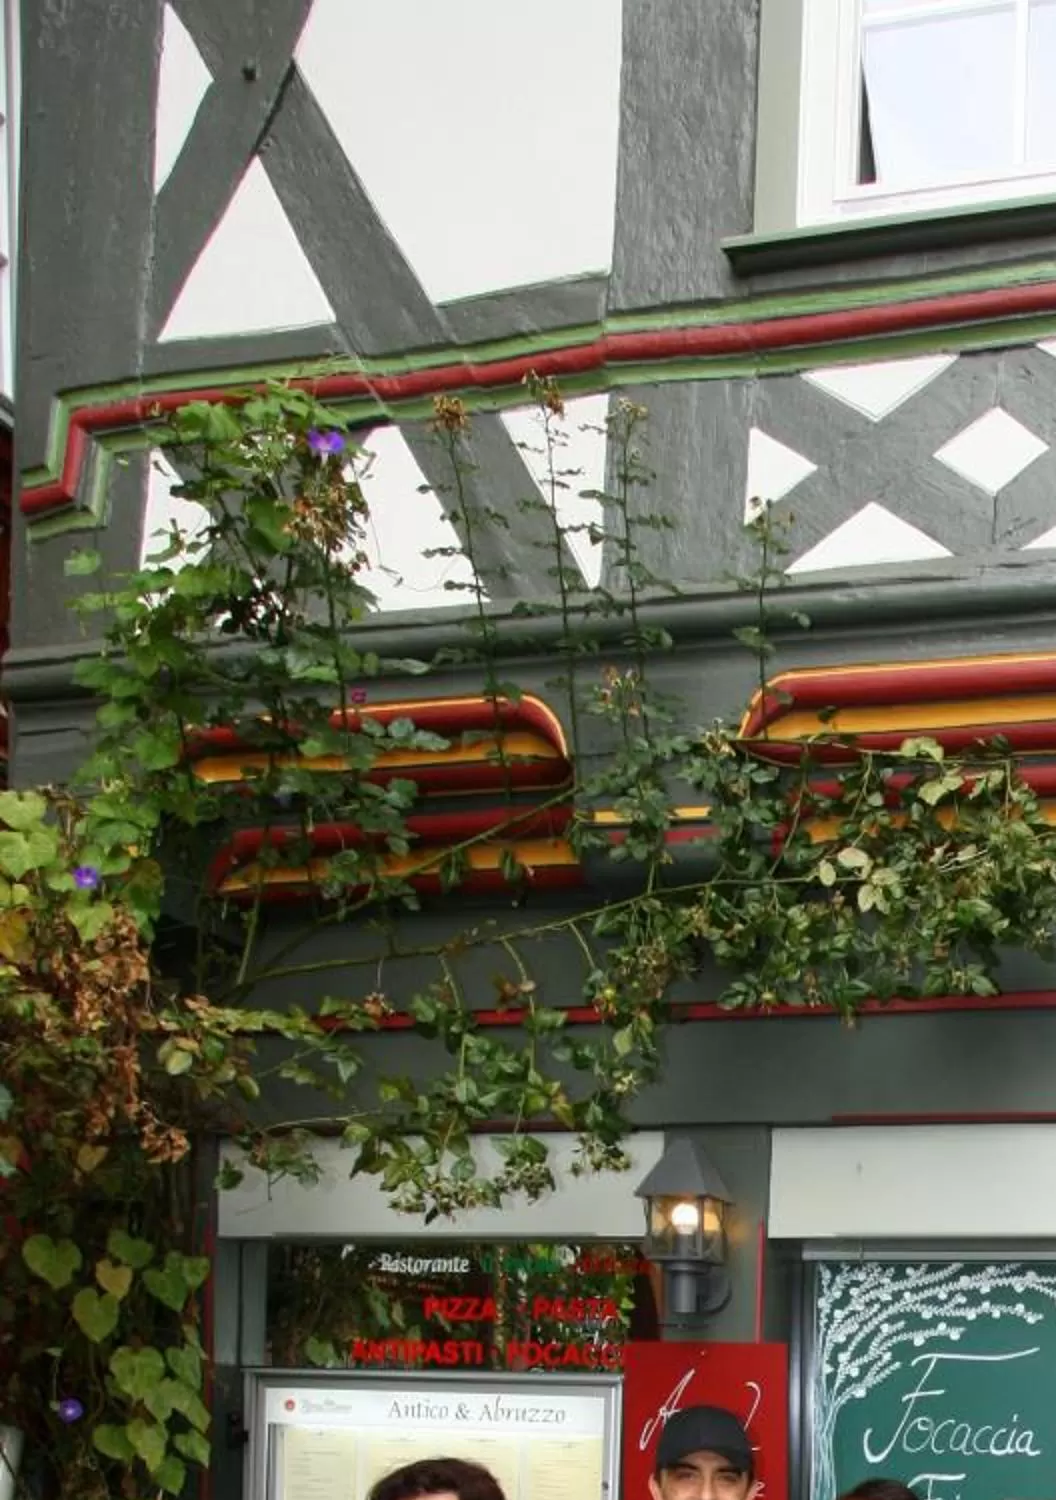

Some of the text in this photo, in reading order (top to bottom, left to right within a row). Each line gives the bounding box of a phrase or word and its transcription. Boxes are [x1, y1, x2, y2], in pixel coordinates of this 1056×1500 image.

[423, 1296, 620, 1322] PIZZA PASTA
[350, 1337, 626, 1369] ANTIPASTI FOCACC
[387, 1395, 567, 1425] Antico & Abruzzo
[863, 1347, 1041, 1463] Focaccia
